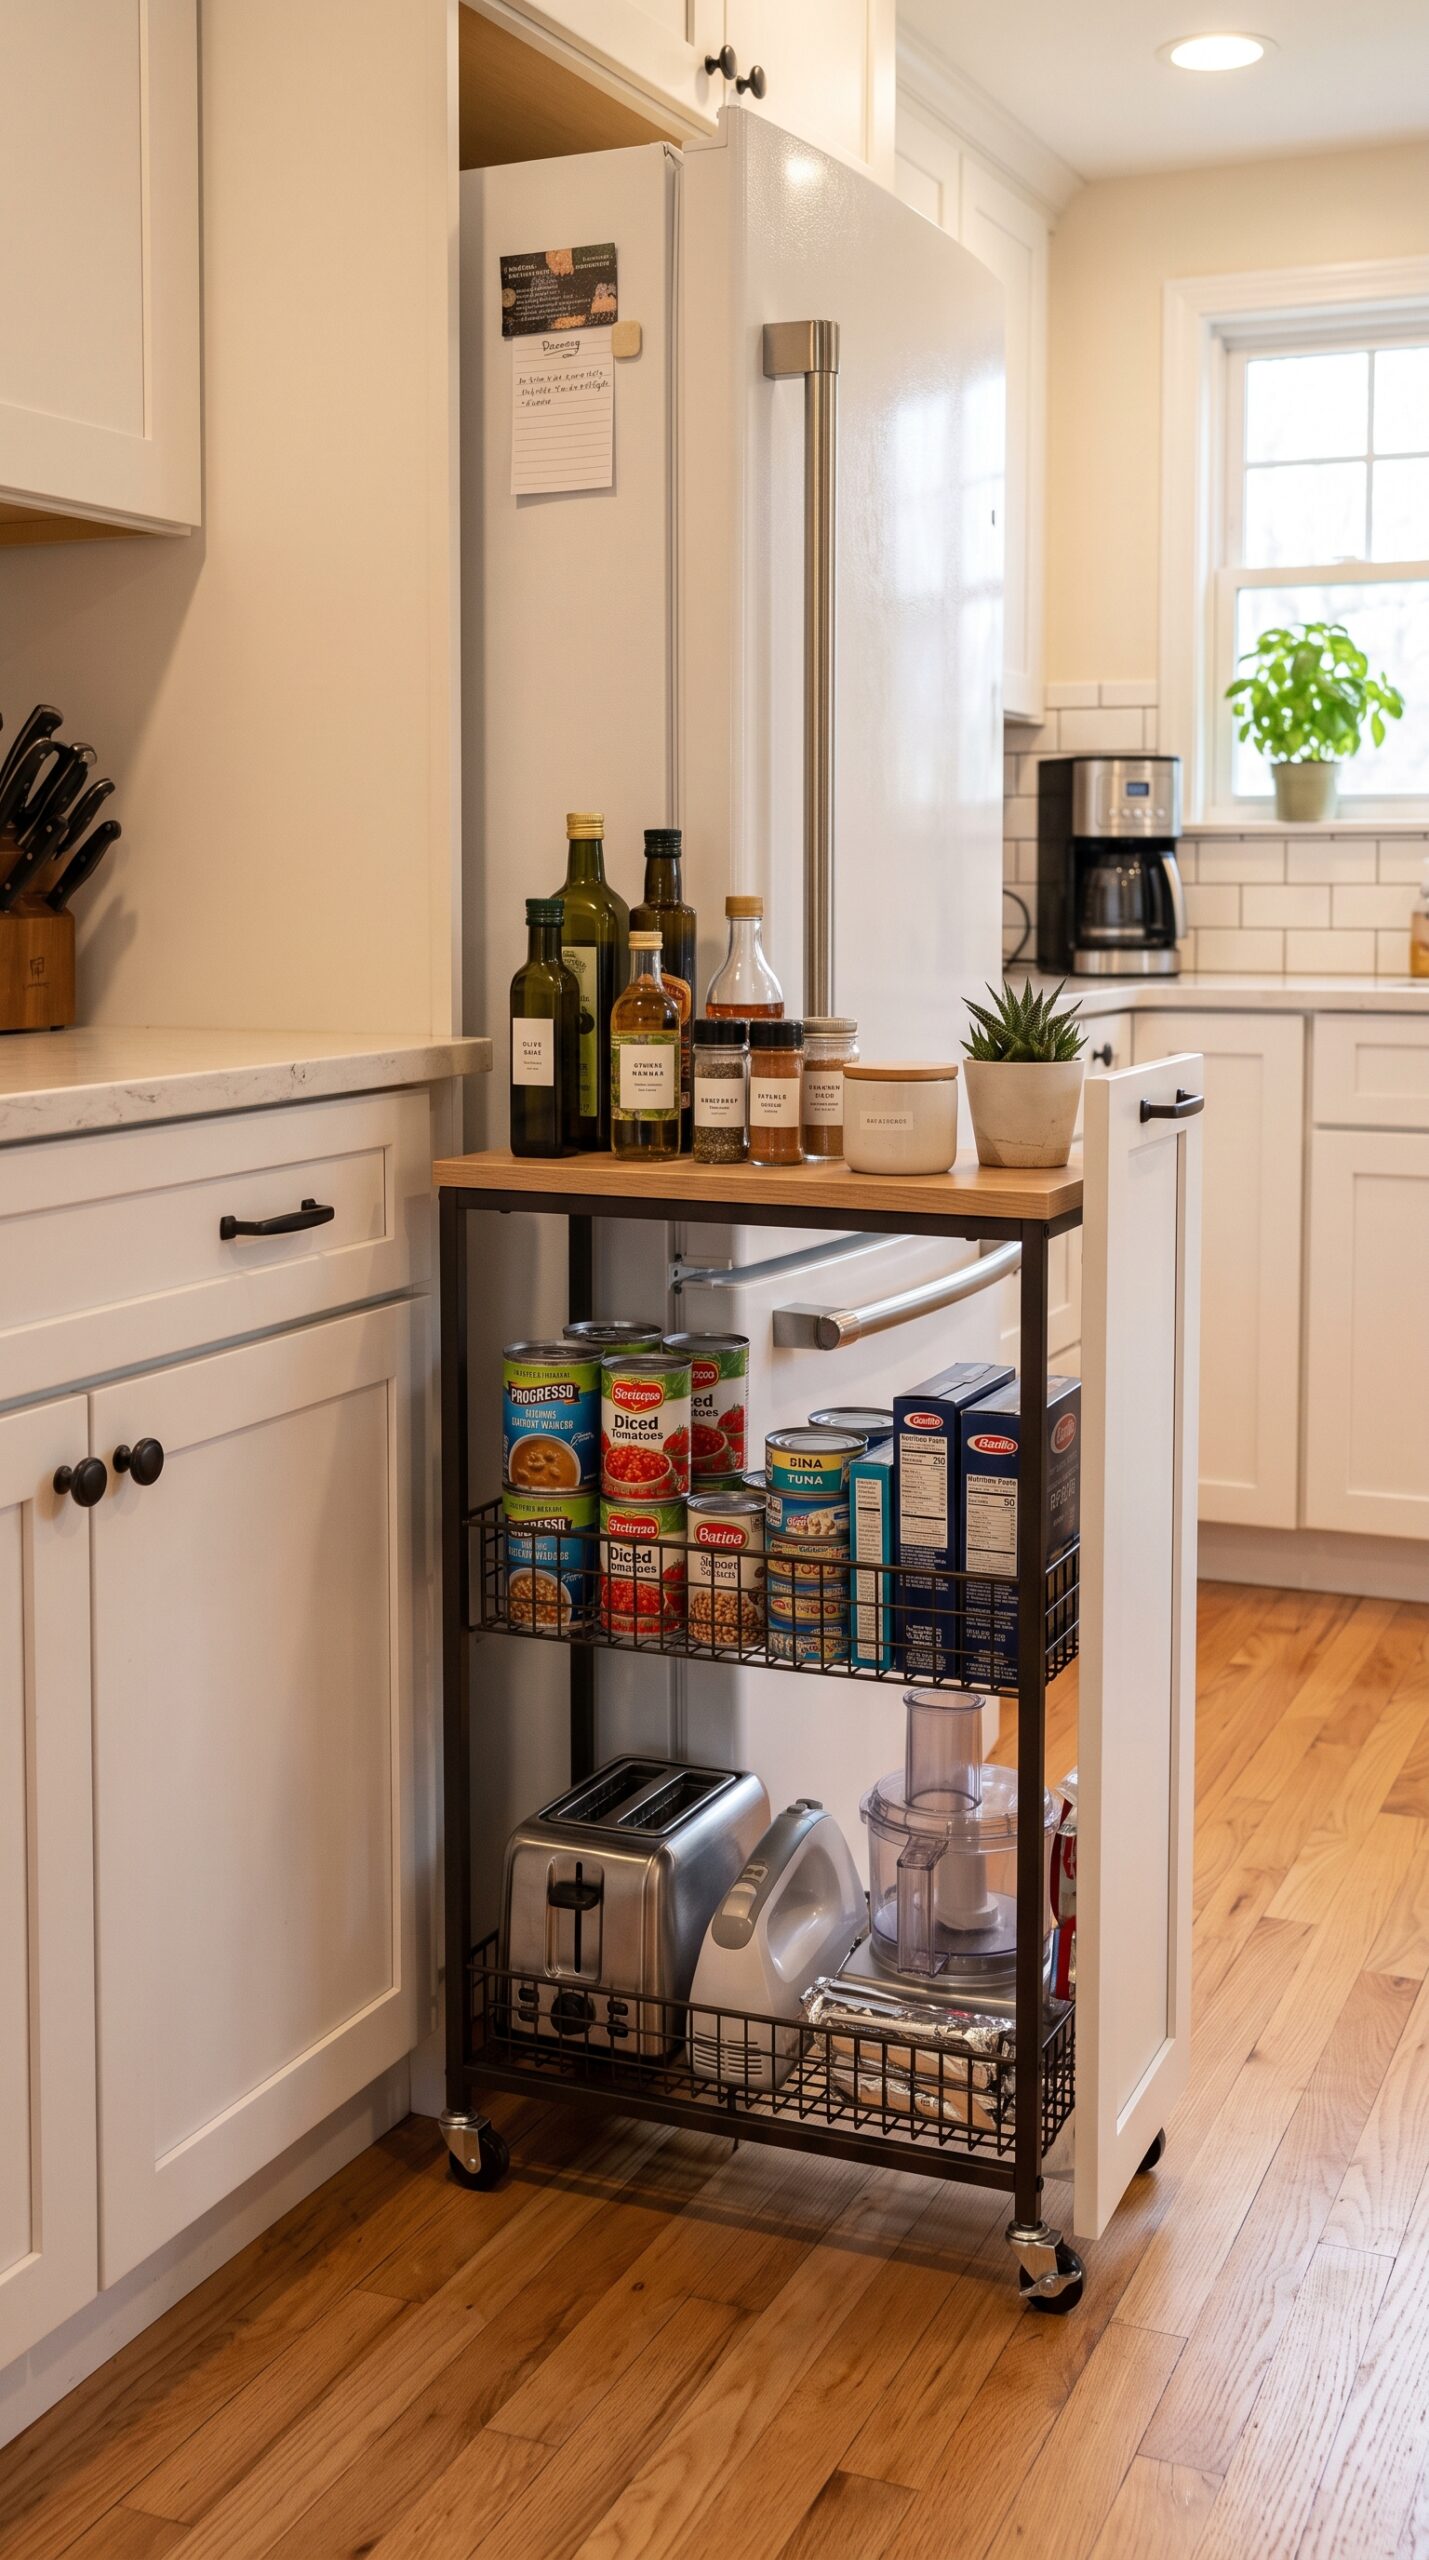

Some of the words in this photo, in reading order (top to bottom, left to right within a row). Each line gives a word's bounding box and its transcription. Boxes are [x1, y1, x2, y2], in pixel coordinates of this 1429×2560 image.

[614, 1414, 659, 1431] Diced
[611, 1428, 664, 1441] Tomatoes
[787, 1473, 824, 1485] TUNA
[610, 1562, 657, 1573] omaoes
